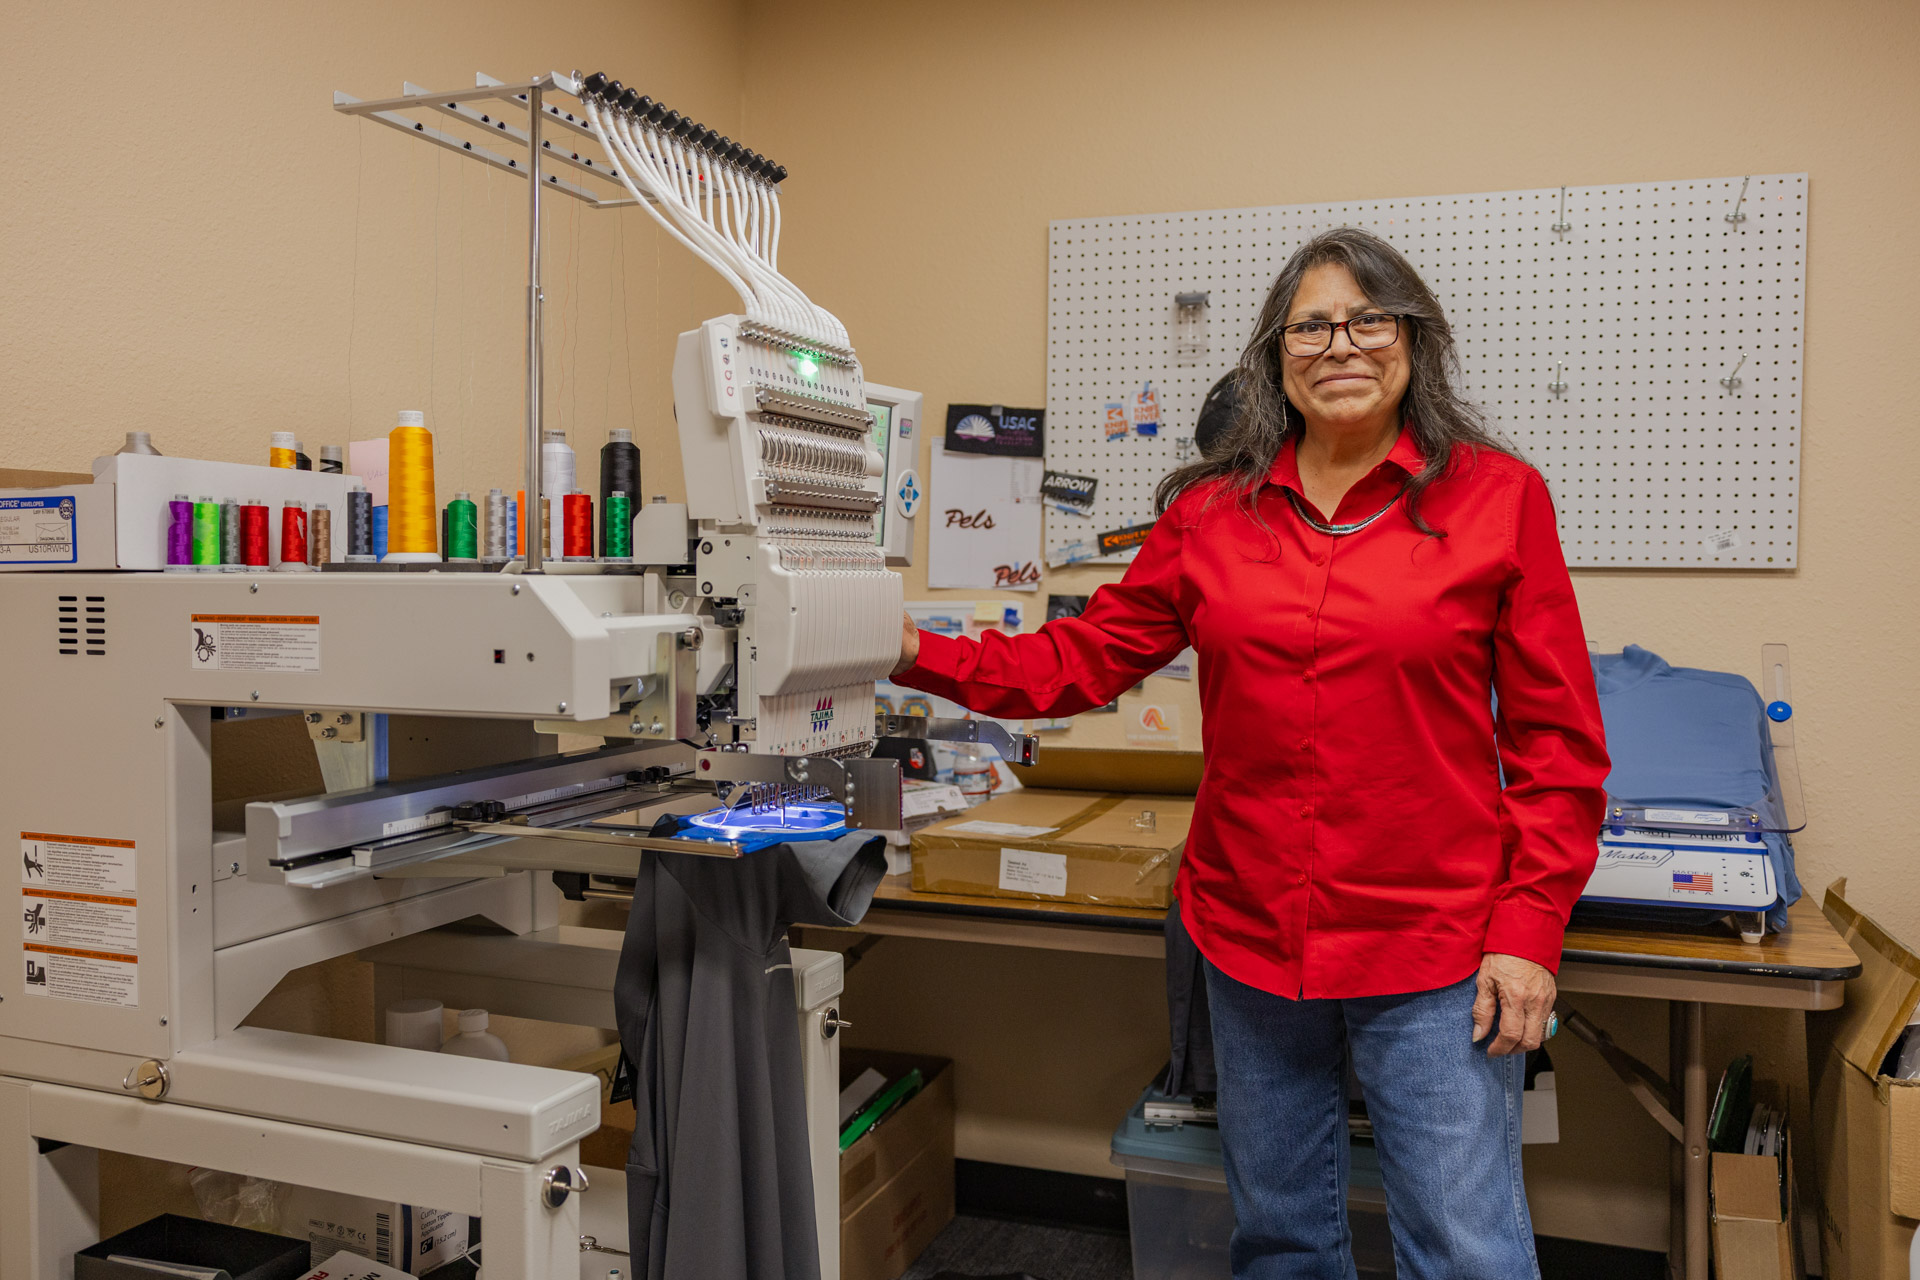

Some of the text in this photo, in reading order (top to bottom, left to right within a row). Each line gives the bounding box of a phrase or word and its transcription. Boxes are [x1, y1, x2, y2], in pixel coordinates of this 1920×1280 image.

[999, 415, 1037, 431] USAC
[1044, 475, 1094, 493] ARROW
[945, 509, 996, 529] Pels
[993, 561, 1041, 586] Pels
[810, 709, 834, 721] TAJIMA
[1601, 849, 1659, 861] Master
[548, 1103, 591, 1136] TAJIMA
[421, 1222, 445, 1237] Applicator
